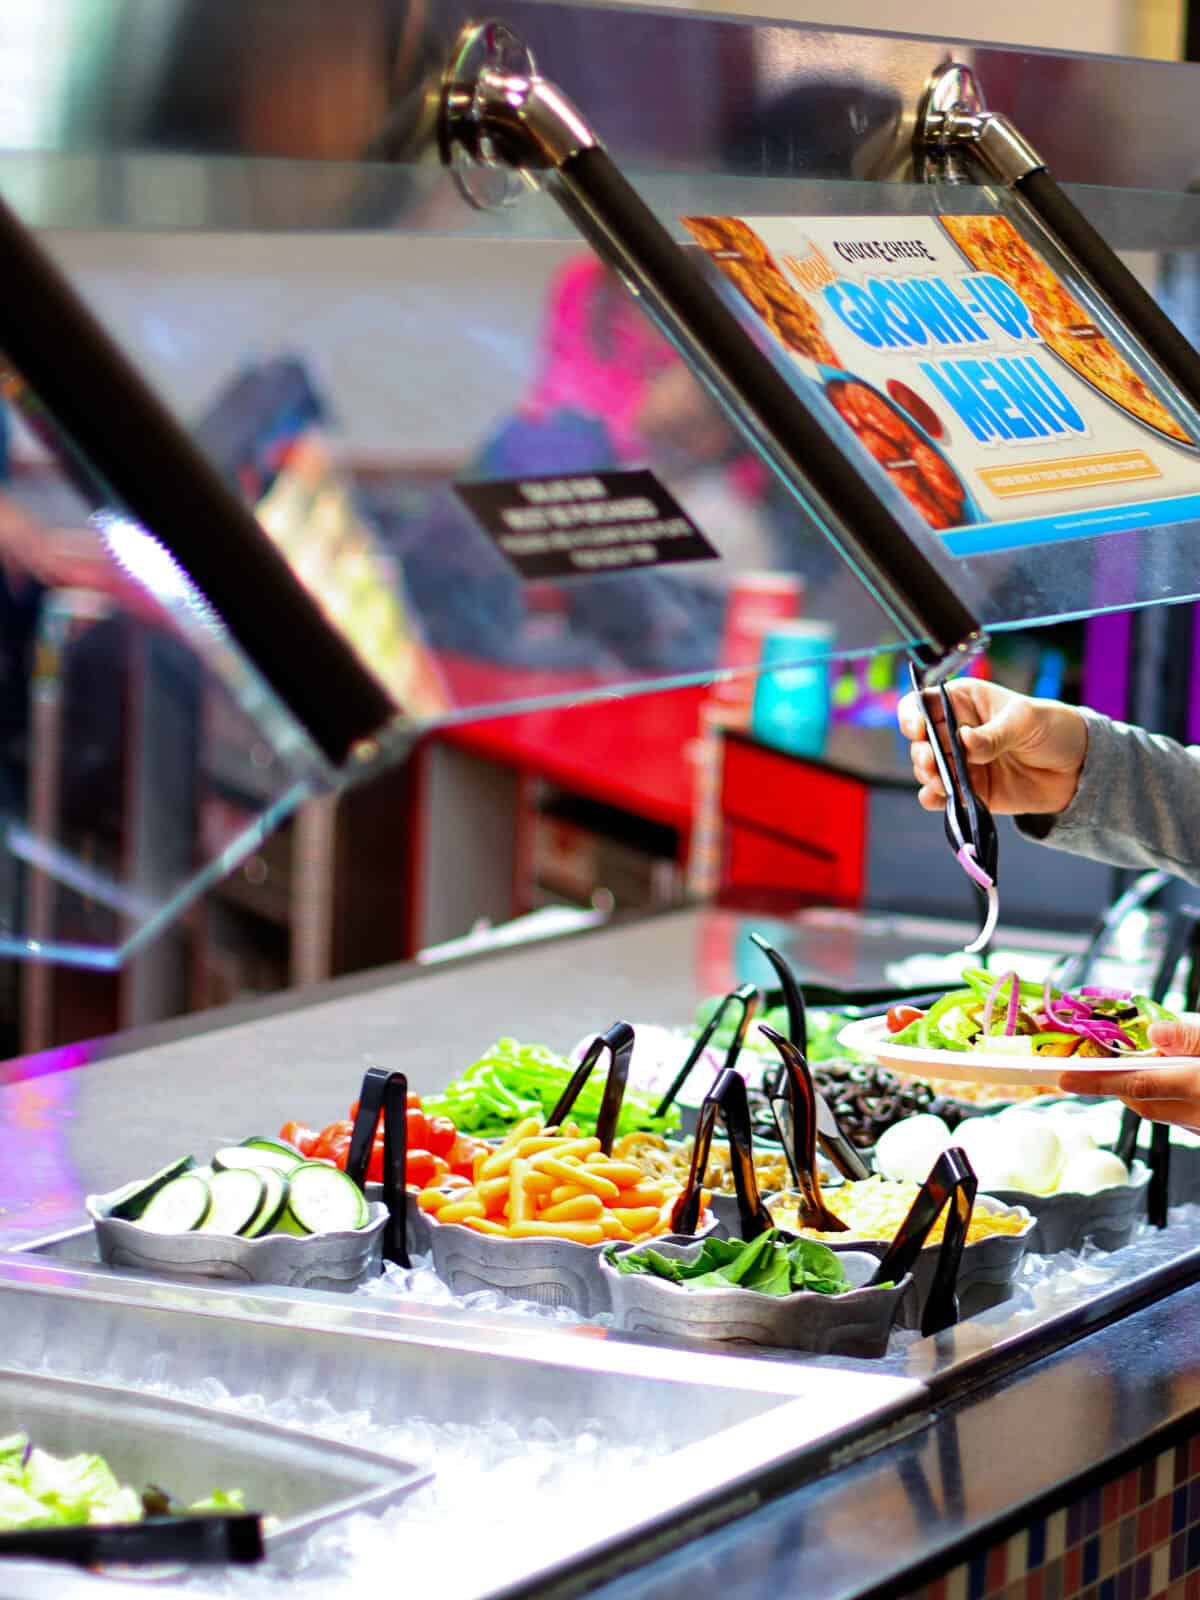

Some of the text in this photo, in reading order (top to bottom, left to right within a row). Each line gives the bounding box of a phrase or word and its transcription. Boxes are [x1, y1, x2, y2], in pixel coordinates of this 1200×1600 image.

[833, 241, 882, 263] CHUCK
[883, 240, 937, 262] CHEESE
[822, 274, 1041, 349] GROWN-UP
[916, 355, 1086, 443] MENU
